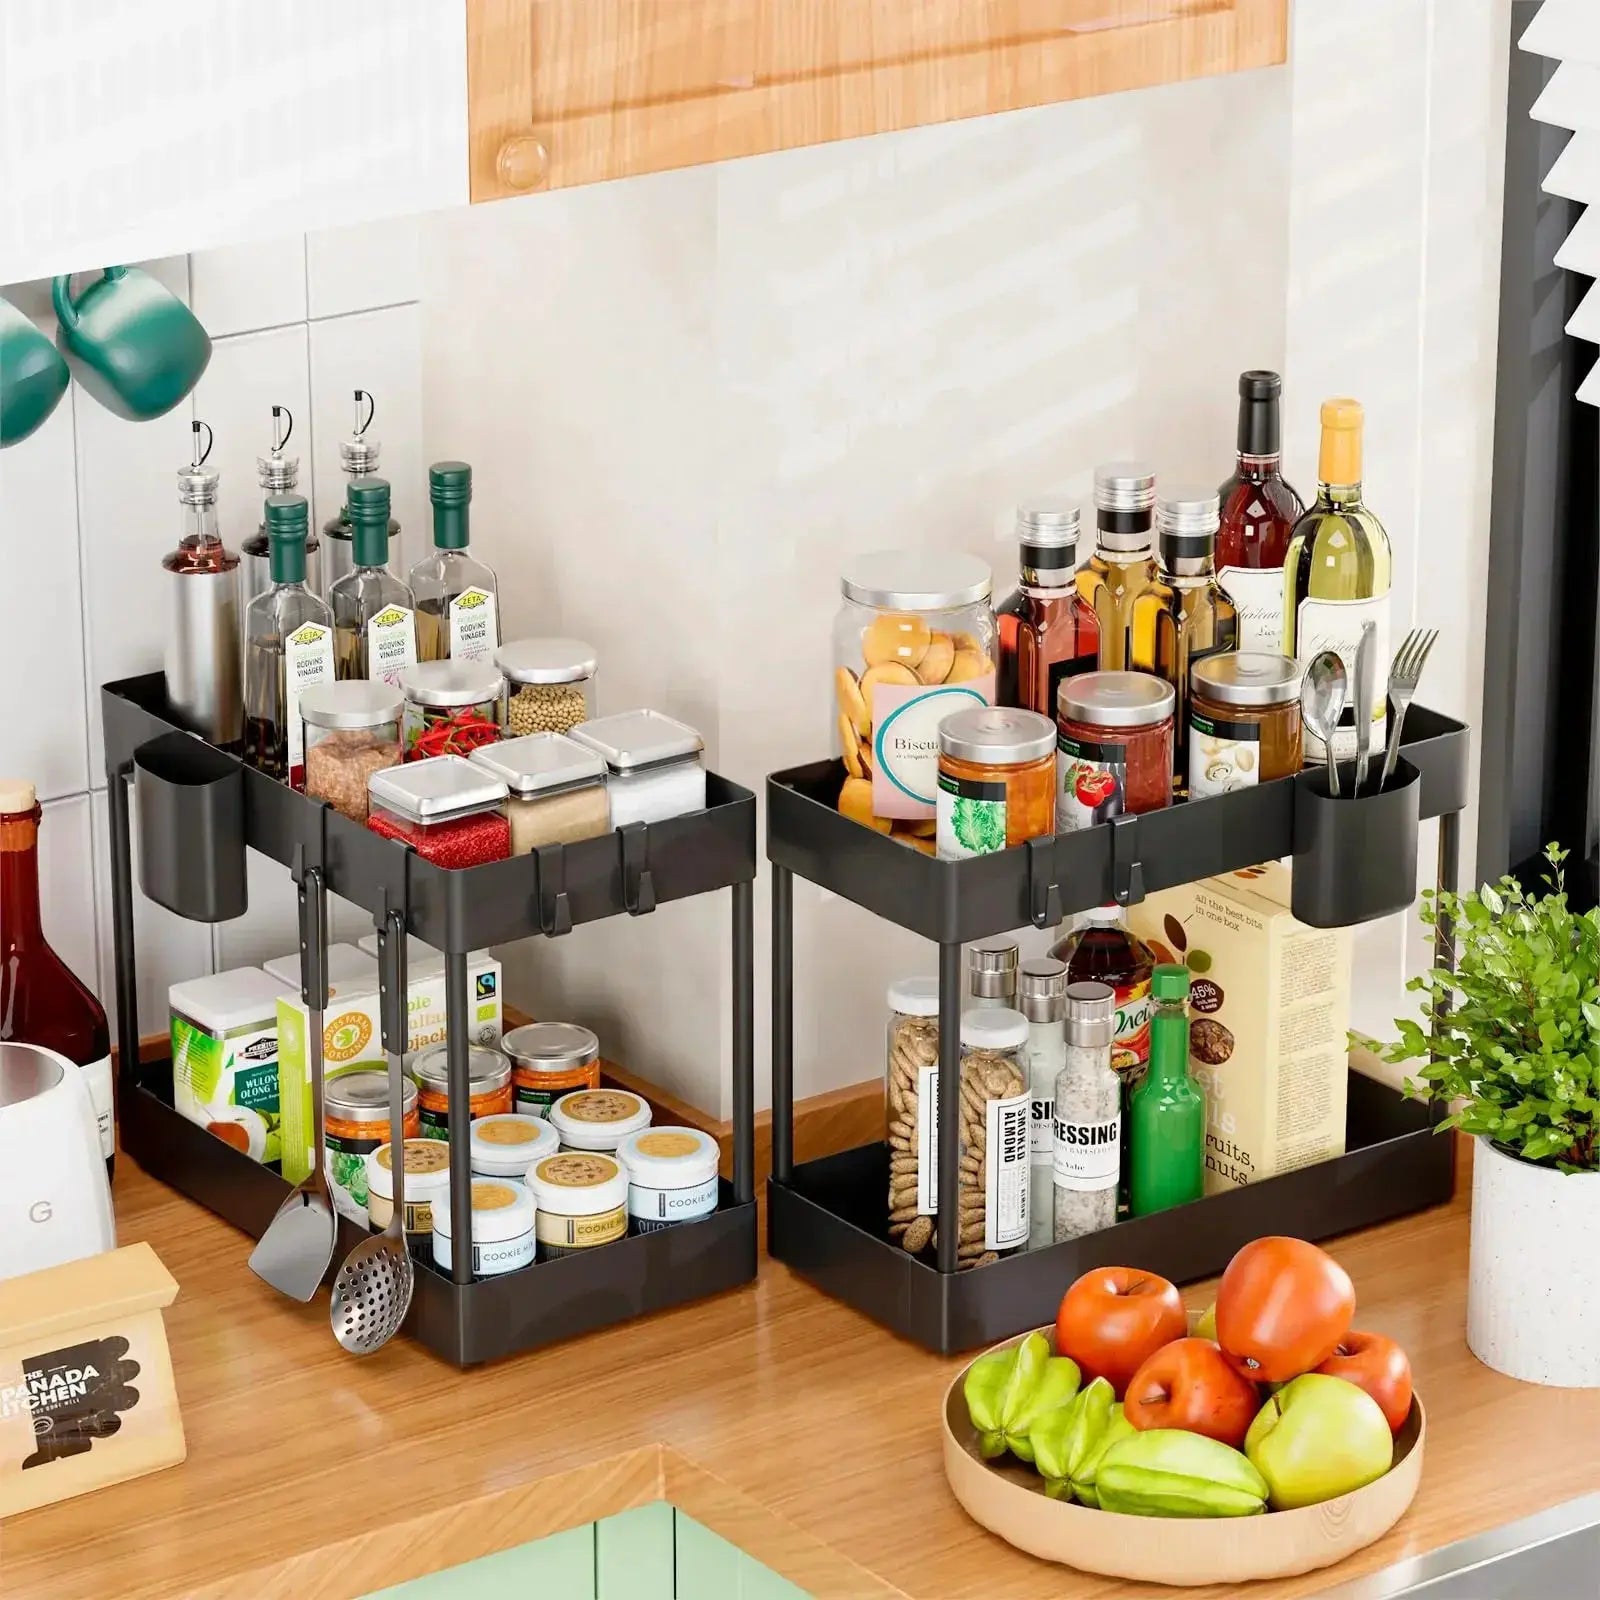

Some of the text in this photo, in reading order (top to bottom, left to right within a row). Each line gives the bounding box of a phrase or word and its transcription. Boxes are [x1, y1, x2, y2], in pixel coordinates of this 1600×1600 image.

[463, 595, 481, 605] ZETA
[381, 613, 400, 622] ZETA
[299, 631, 318, 640] ZETA
[1195, 894, 1263, 930] all the best bits
[1195, 905, 1239, 931] in one box
[1191, 983, 1216, 999] 45%
[240, 1085, 270, 1099] OLONG
[1004, 1112, 1016, 1163] ALMOND
[1017, 1107, 1027, 1160] SMOKED
[1054, 1118, 1117, 1146] RESSING
[1205, 1132, 1255, 1172] ruits,
[668, 1194, 705, 1208] COOKIE
[29, 1201, 53, 1223] G
[577, 1220, 615, 1234] COOKIE
[483, 1247, 521, 1261] COOKIE
[1, 1364, 100, 1402] PANADA
[25, 1370, 44, 1380] THE
